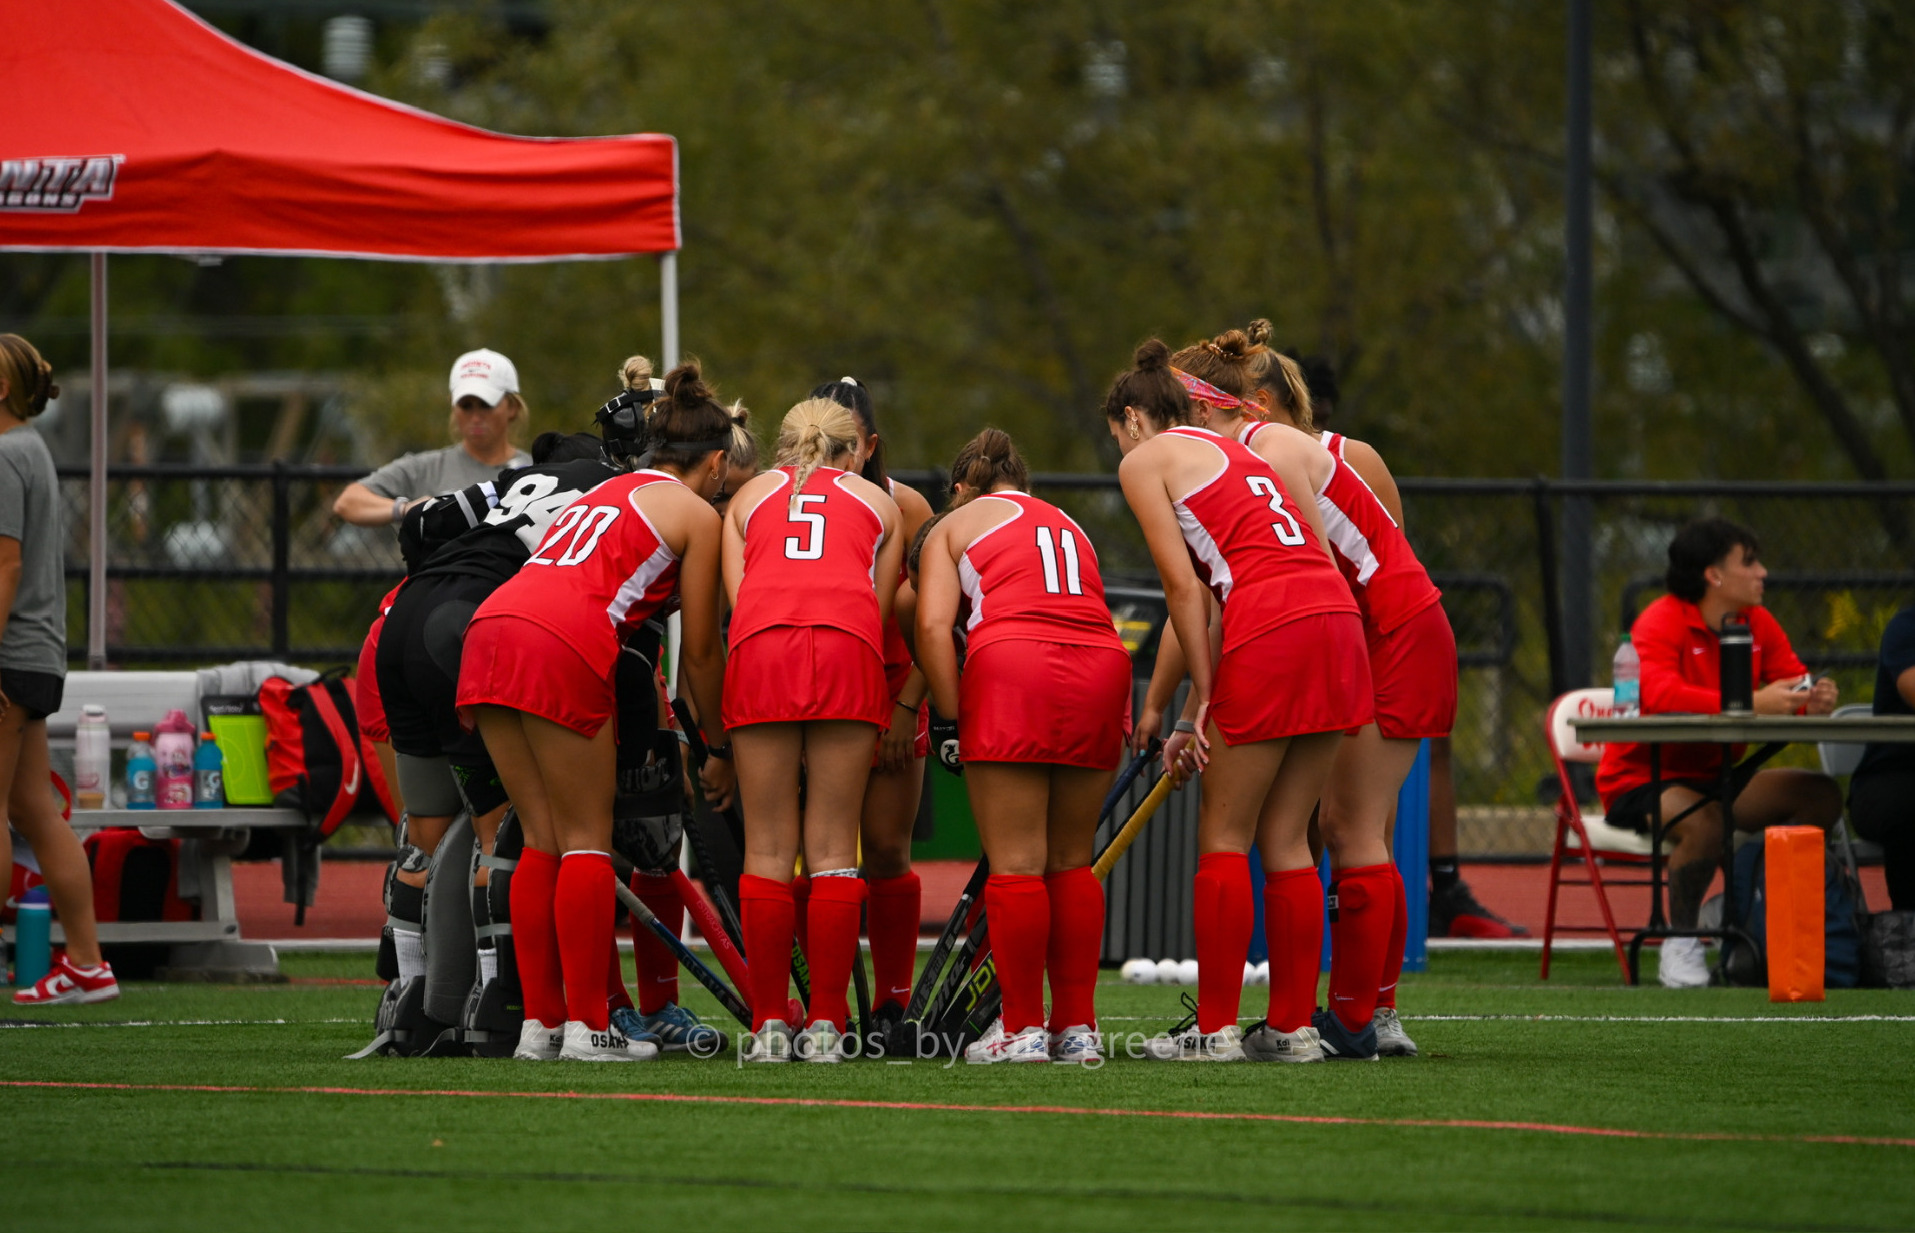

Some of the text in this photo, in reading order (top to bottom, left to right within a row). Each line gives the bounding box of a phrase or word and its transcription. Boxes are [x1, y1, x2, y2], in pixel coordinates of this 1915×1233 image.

[482, 473, 584, 554] 94
[523, 504, 621, 567] 20
[784, 494, 826, 560] 5
[1245, 475, 1307, 546] 3
[1035, 526, 1083, 596] 11
